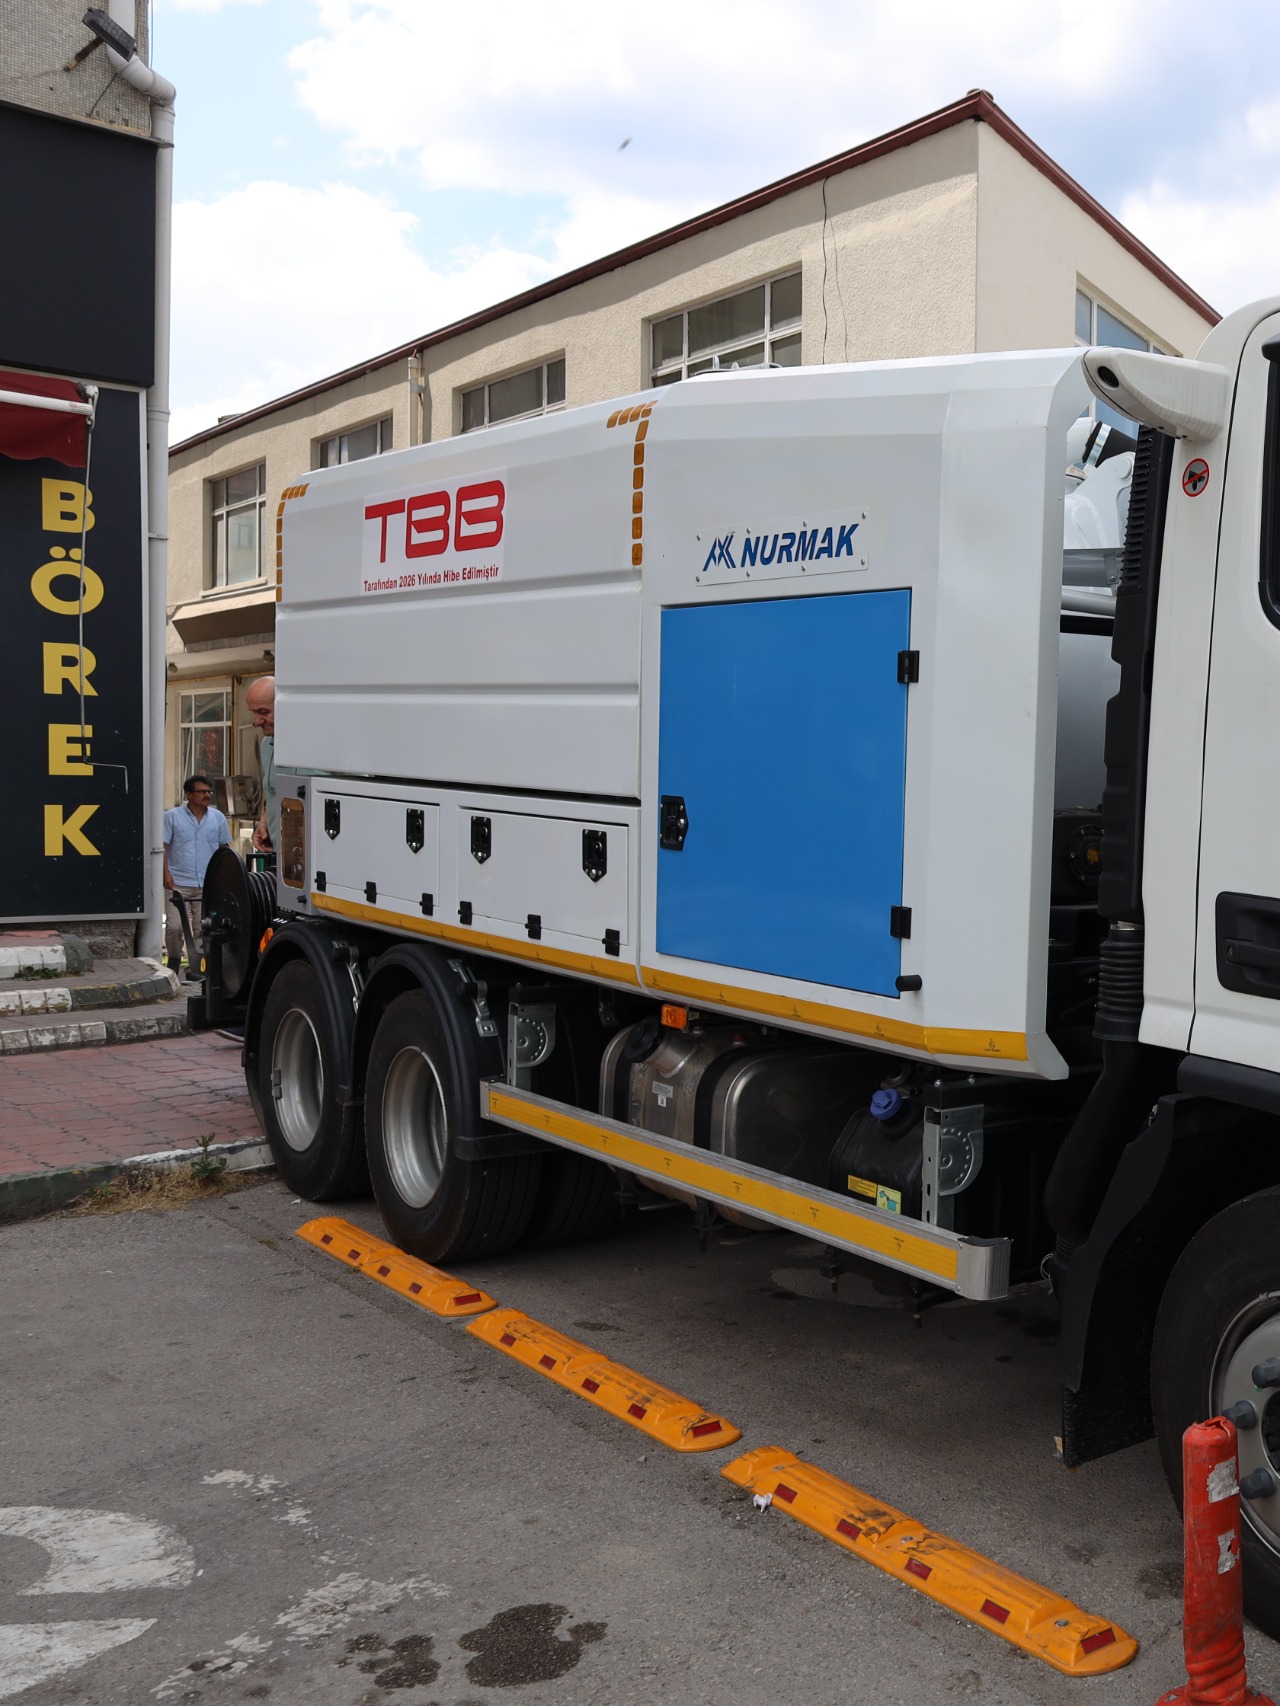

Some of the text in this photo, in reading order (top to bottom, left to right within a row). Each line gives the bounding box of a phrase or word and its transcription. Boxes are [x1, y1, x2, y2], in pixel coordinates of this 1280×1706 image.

[365, 480, 506, 564] TBB
[740, 523, 860, 568] NURMAK
[399, 574, 416, 588] 2026
[417, 571, 441, 586] Yılında
[443, 569, 460, 583] Hibe
[462, 564, 500, 581] Edilmiştir
[31, 477, 104, 857] BÖREK
